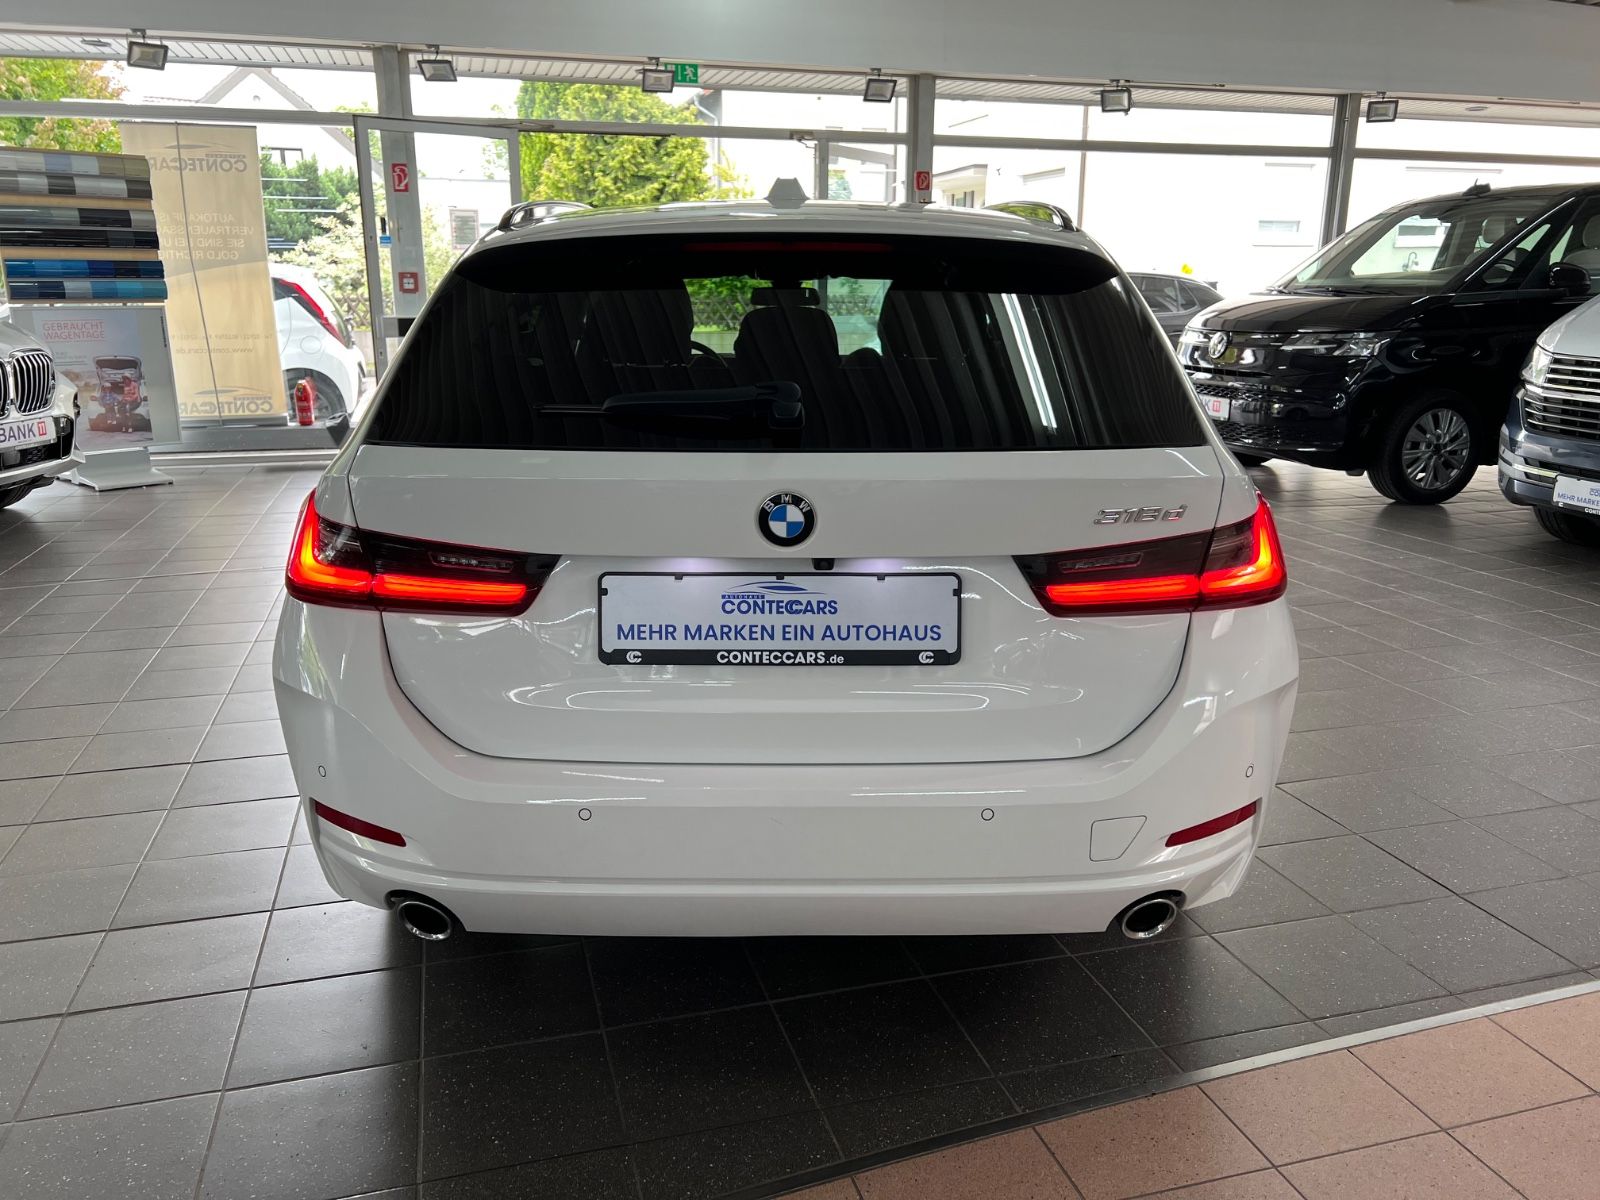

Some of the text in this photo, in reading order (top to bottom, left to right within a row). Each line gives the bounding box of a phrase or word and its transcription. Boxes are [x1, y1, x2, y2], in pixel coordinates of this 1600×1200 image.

[43, 321, 104, 332] GEBRAUCHT
[44, 330, 105, 341] WAGENTAGE
[0, 423, 36, 443] BANK
[763, 493, 812, 513] BMW
[1094, 503, 1188, 525] 318d
[721, 599, 838, 615] CONTECCARS
[616, 624, 942, 642] MEHR MARKEN EIN AUTOHAUS
[716, 650, 845, 665] CONTECCARS.de
